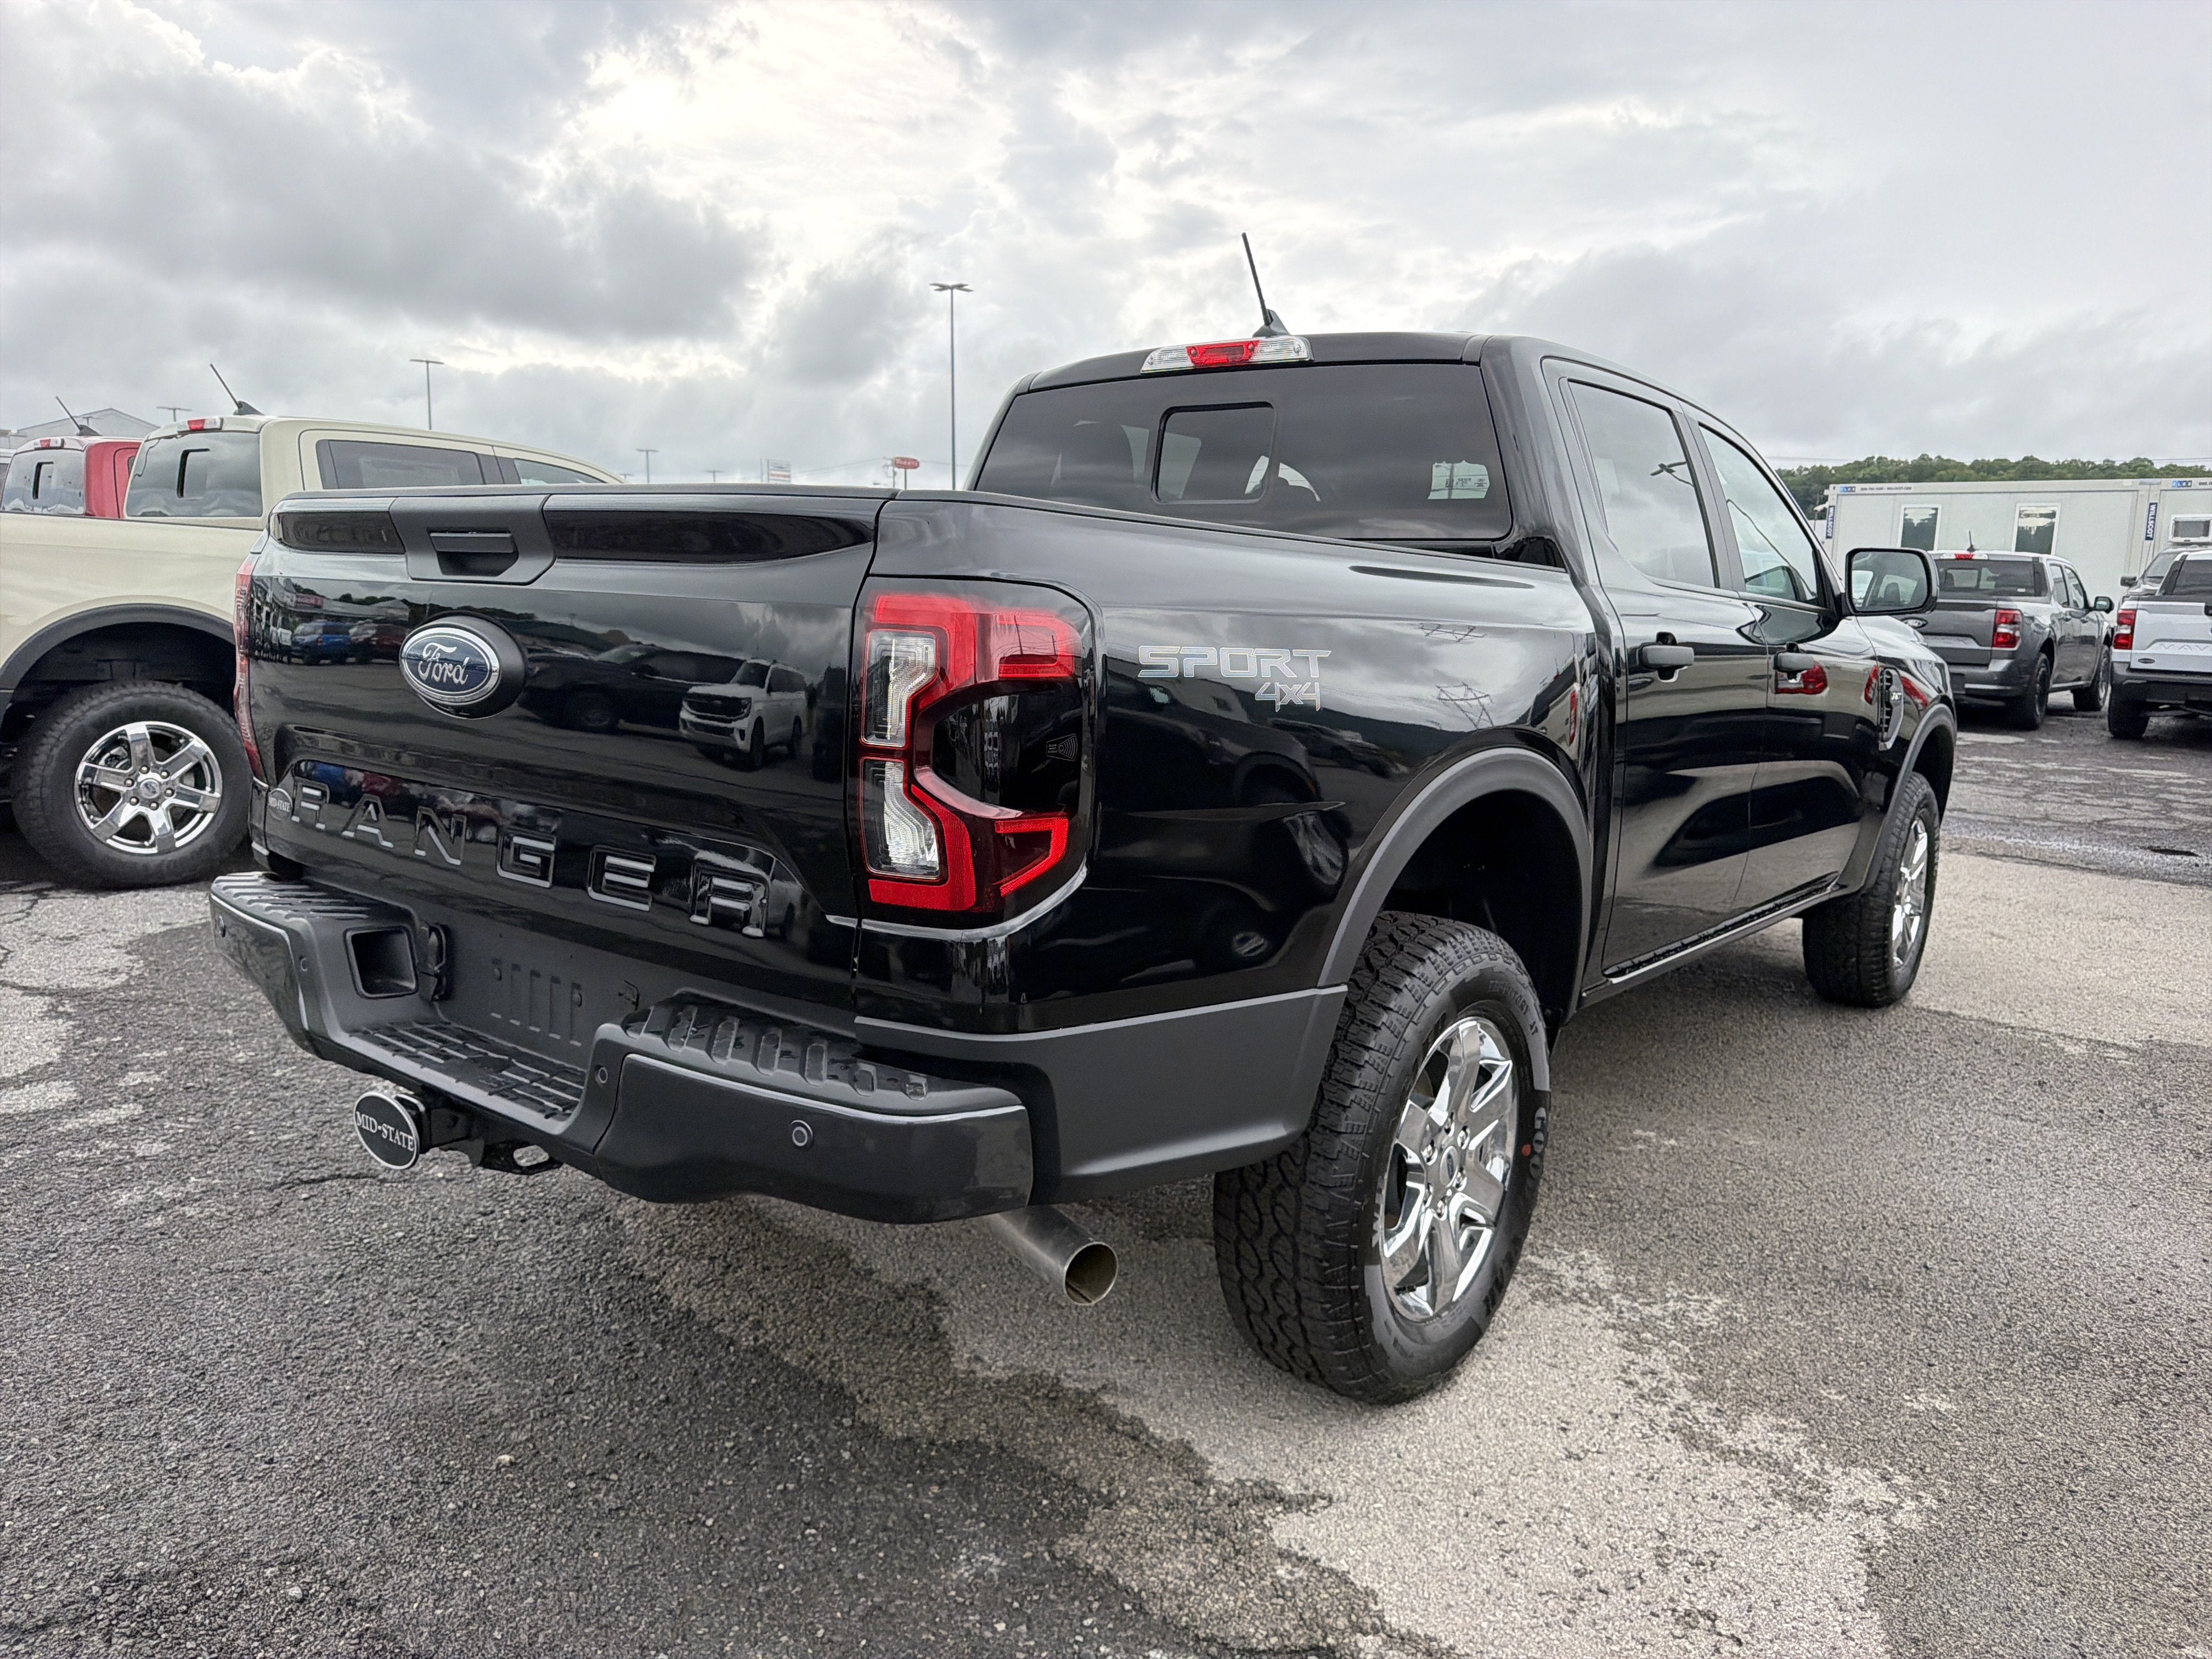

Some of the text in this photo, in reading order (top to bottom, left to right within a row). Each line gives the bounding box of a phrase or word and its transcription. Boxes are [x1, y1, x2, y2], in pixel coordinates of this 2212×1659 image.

[2146, 504, 2157, 538] WILLSCOT
[418, 642, 470, 685] Ford
[1137, 645, 1332, 678] SPORT
[291, 776, 769, 938] RANGER
